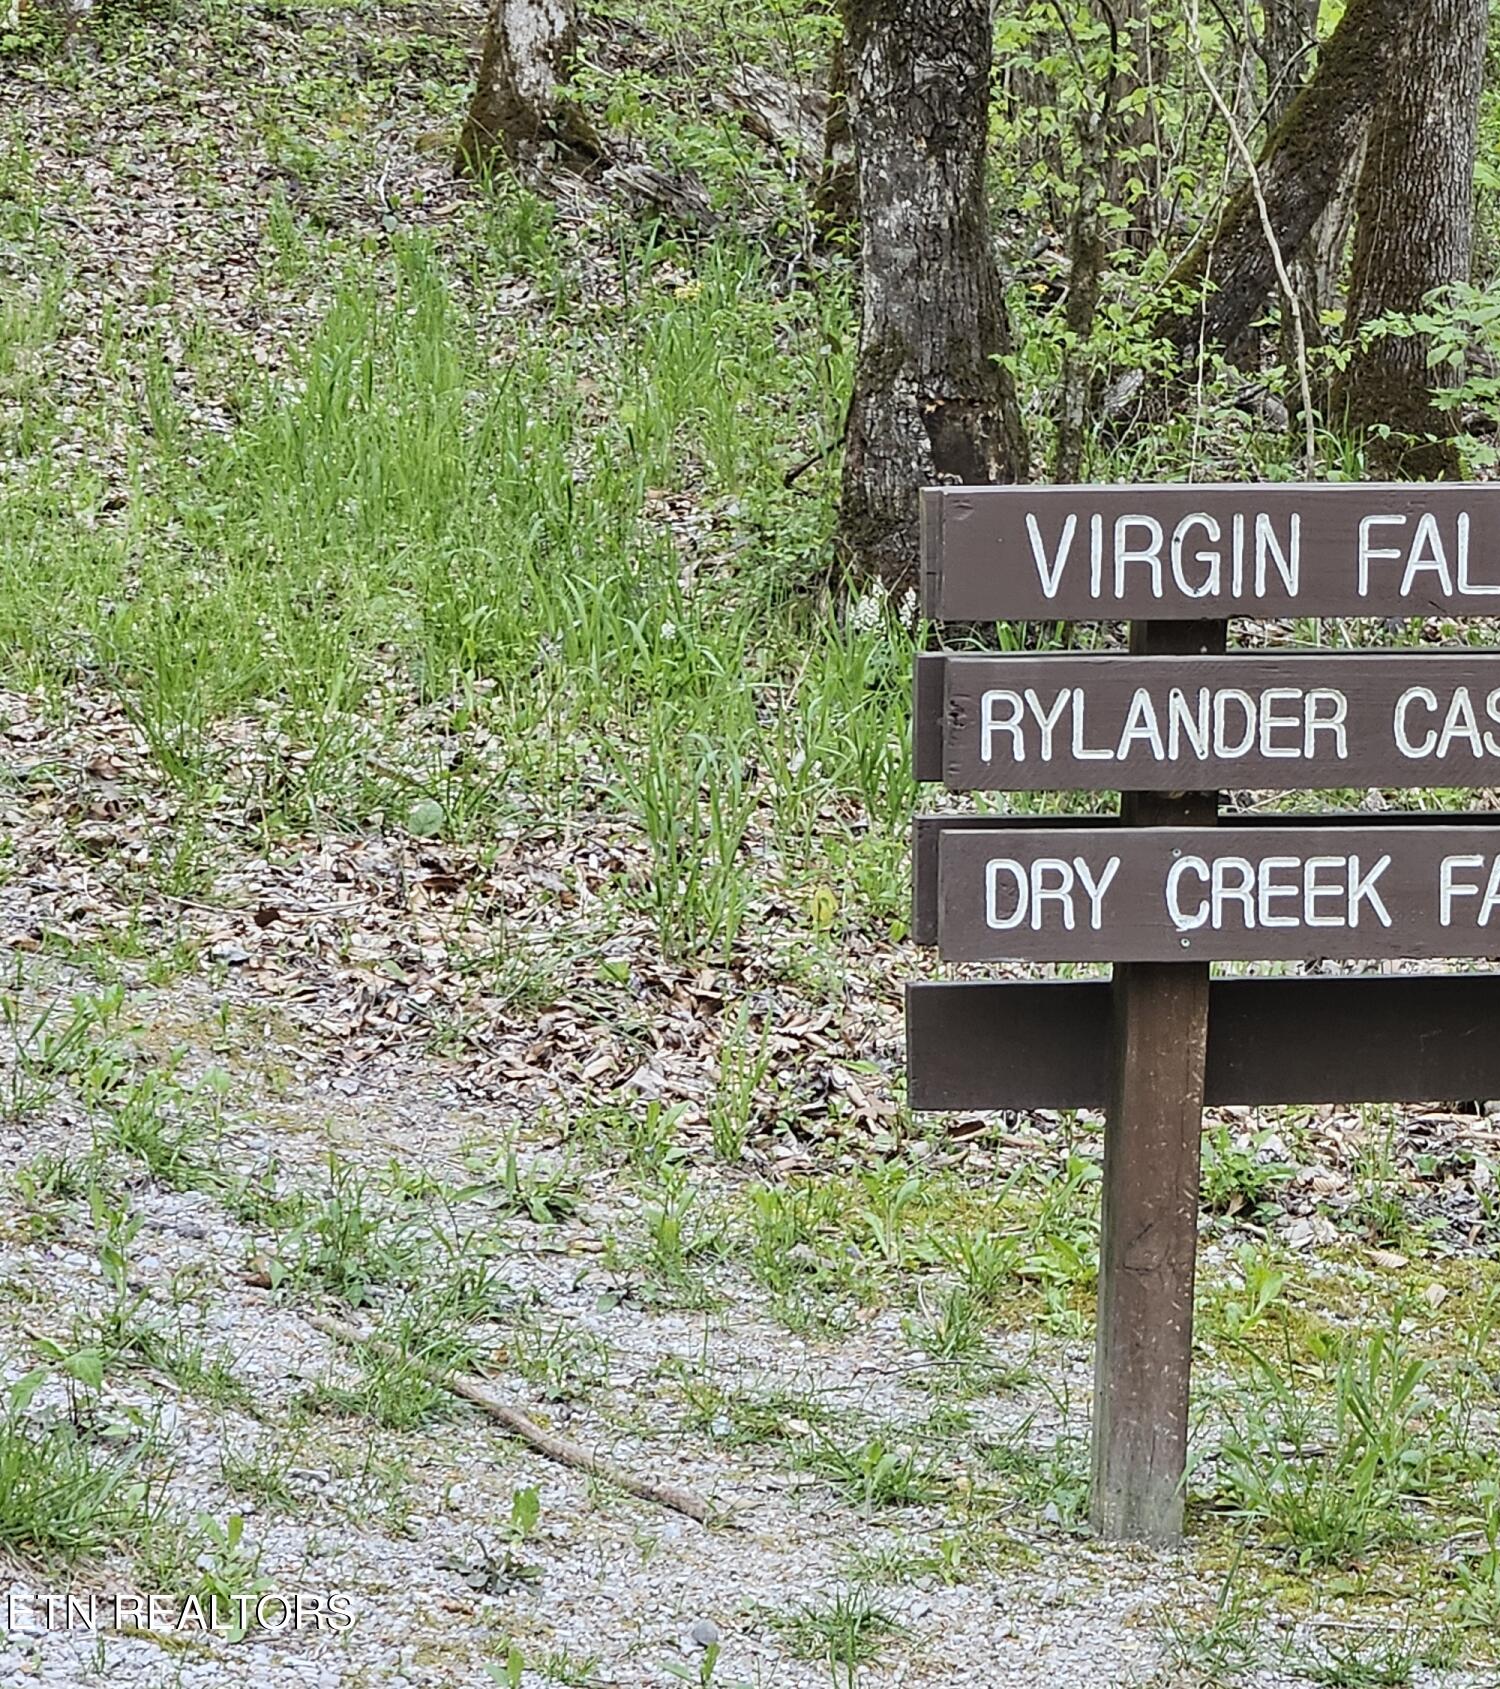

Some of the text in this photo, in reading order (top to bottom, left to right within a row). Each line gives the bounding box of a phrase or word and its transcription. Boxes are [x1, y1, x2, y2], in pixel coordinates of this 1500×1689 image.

[1025, 512, 1301, 599] VIRGIN
[980, 686, 1348, 762] RYLANDER
[984, 856, 1121, 931] DRY
[1165, 854, 1393, 932] CREEK
